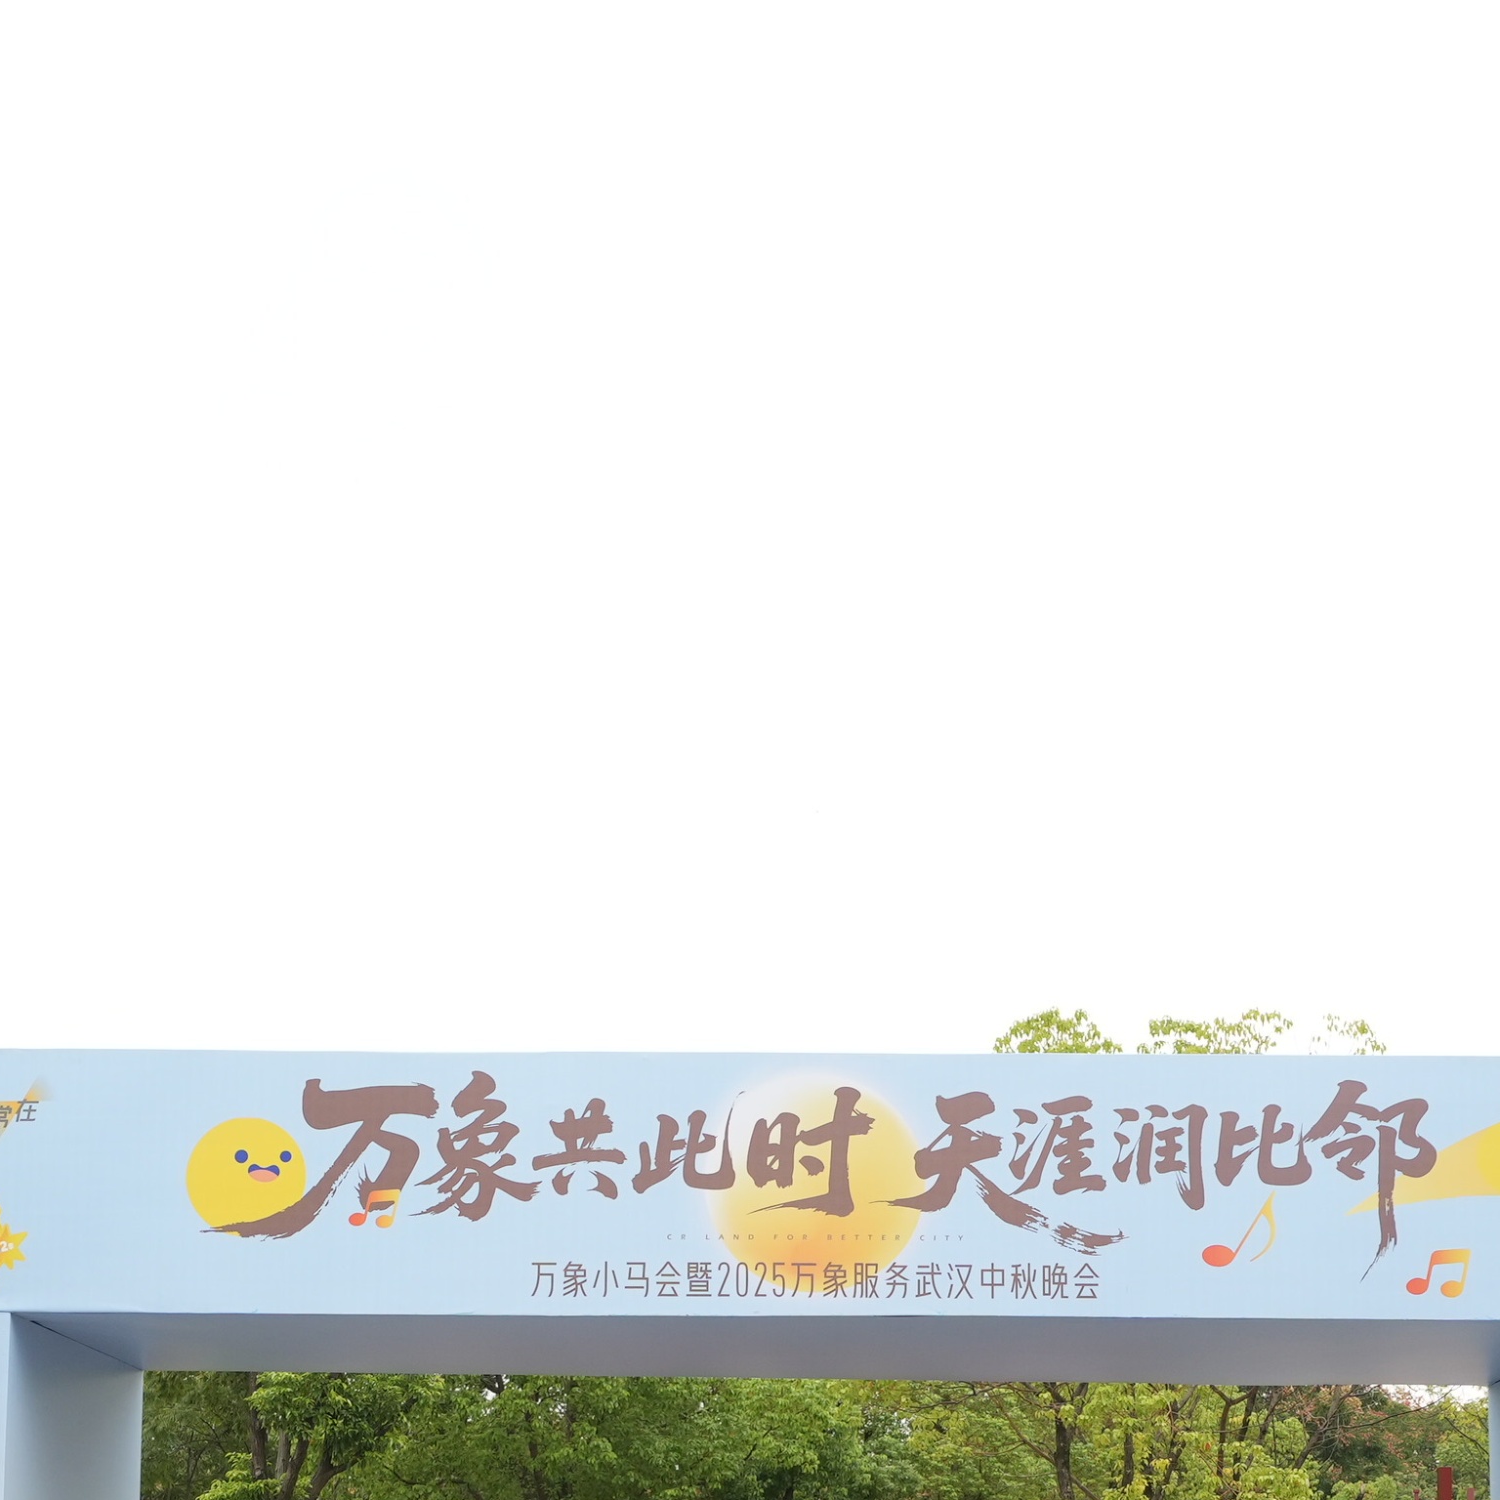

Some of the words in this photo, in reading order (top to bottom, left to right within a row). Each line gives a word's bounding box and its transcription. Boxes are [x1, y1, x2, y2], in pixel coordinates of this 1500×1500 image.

[201, 1071, 876, 1241] 万象共此时
[868, 1079, 1438, 1283] 天涯润比邻
[666, 1232, 687, 1242] CR
[705, 1232, 742, 1242] LAND
[773, 1232, 809, 1242] FOR
[827, 1232, 902, 1242] BETTER
[919, 1232, 965, 1242] CITY
[531, 1261, 1100, 1300] 万象小马会暨2025万象服务武汉中秋晚会
